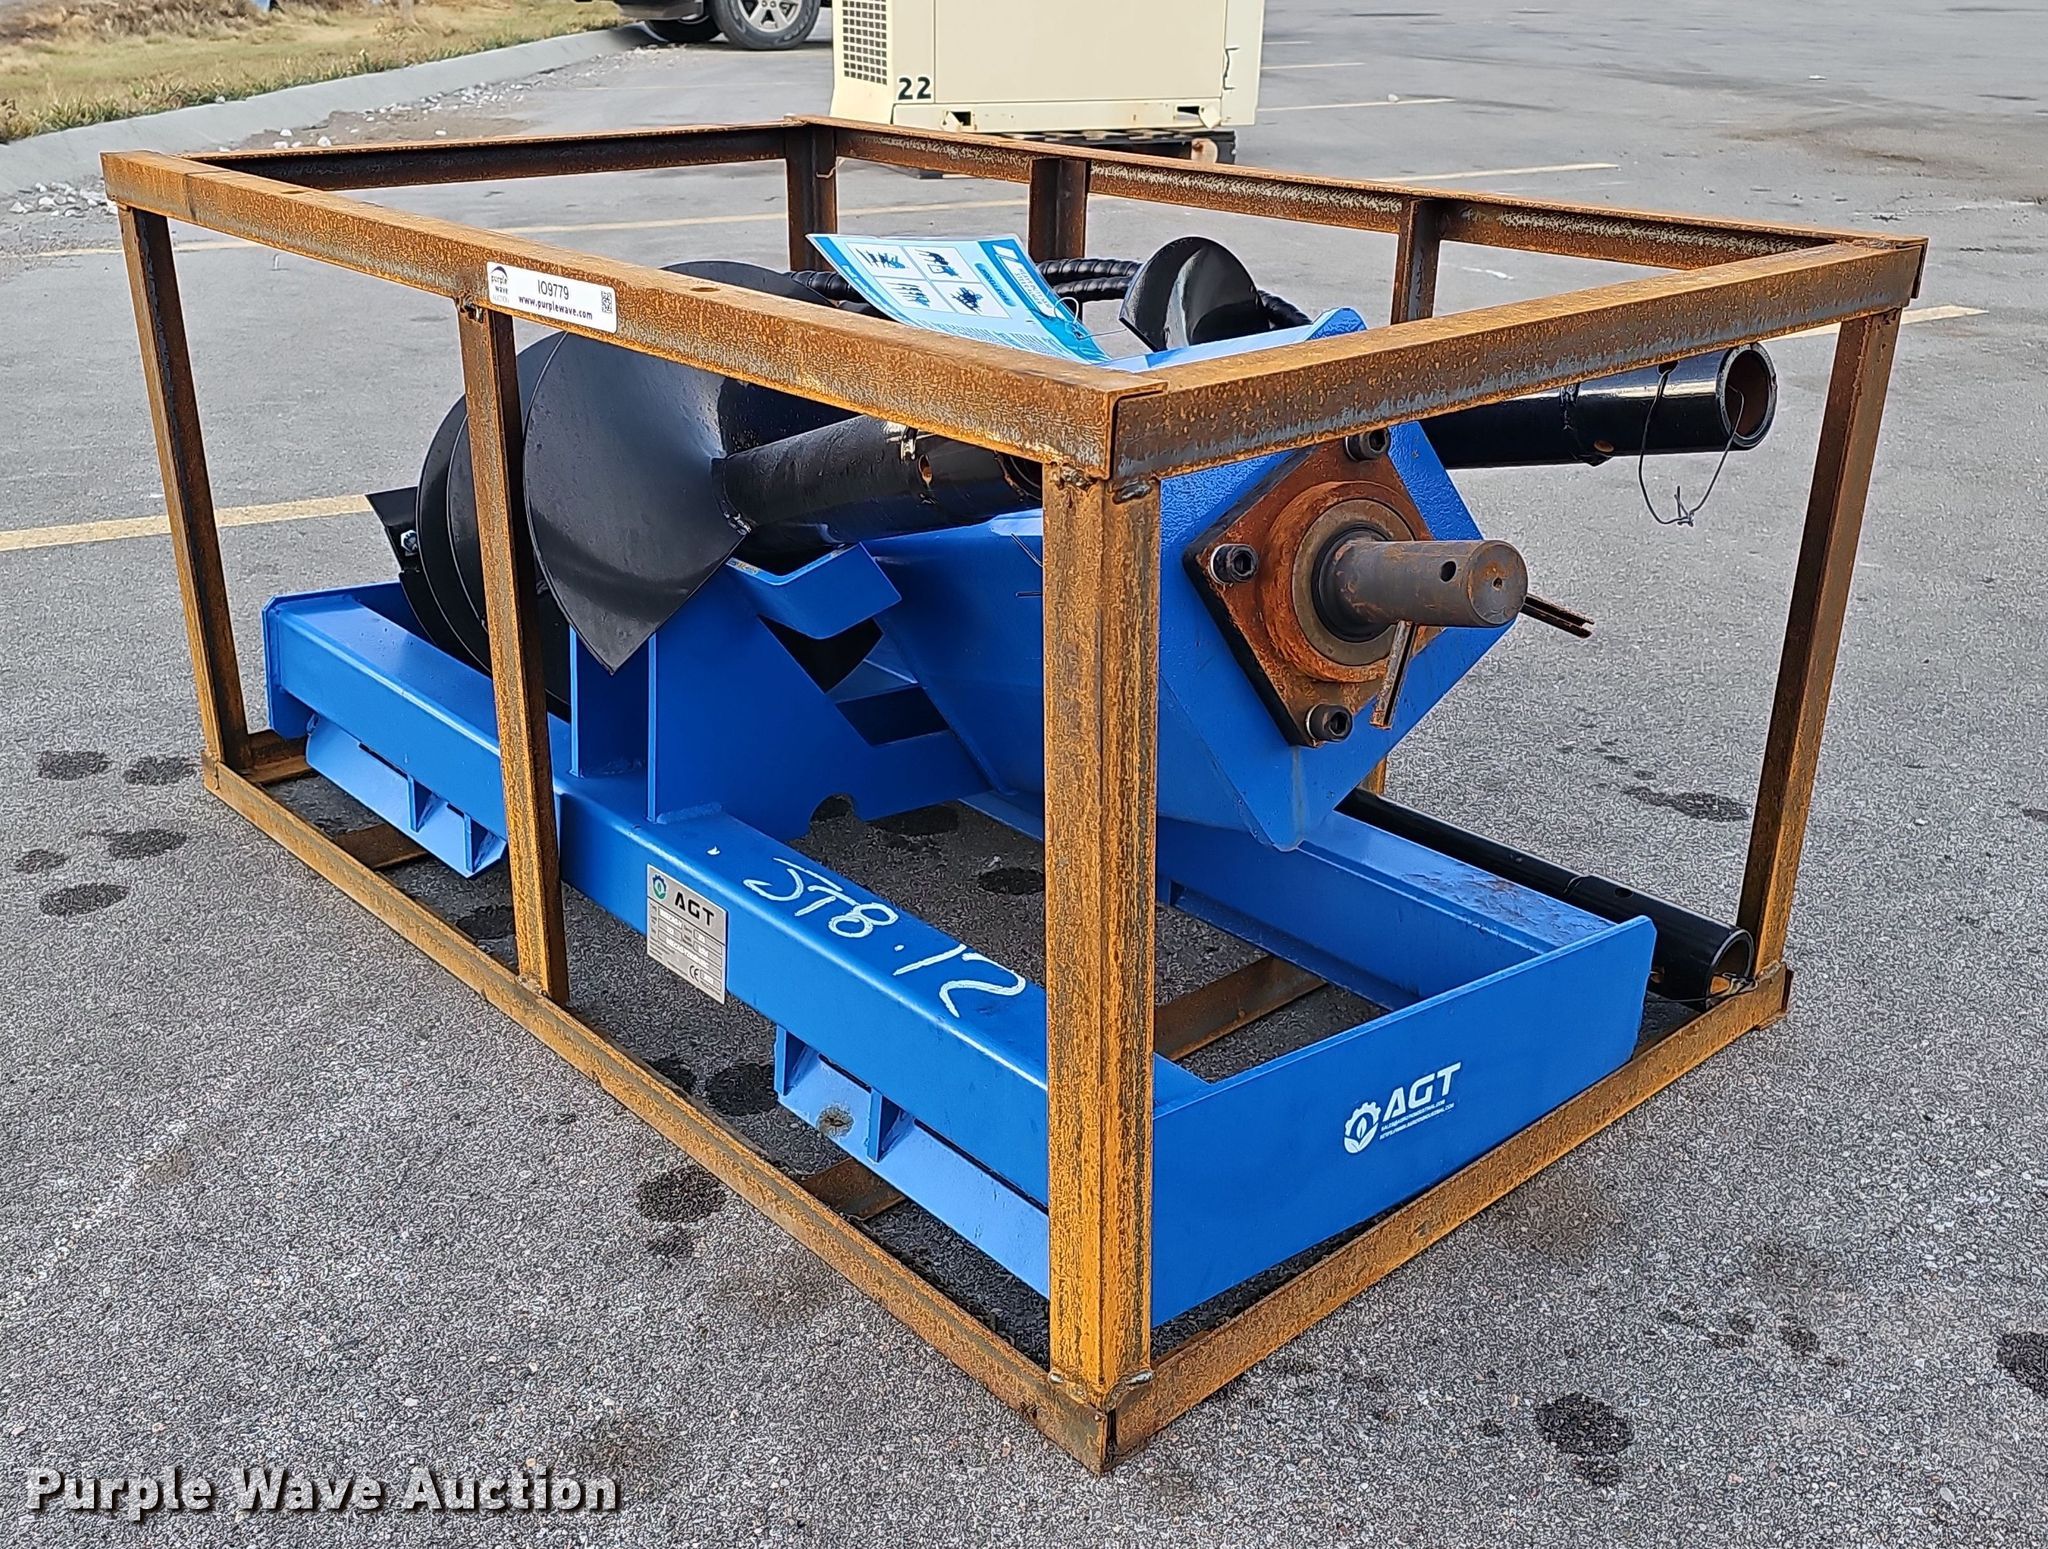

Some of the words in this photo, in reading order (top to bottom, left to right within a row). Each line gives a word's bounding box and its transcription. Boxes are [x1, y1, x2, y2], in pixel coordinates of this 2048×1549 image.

[899, 77, 931, 100] 22
[518, 295, 593, 320] www.purplewave.com
[674, 891, 715, 926] AGT
[1382, 1061, 1462, 1122] AGT
